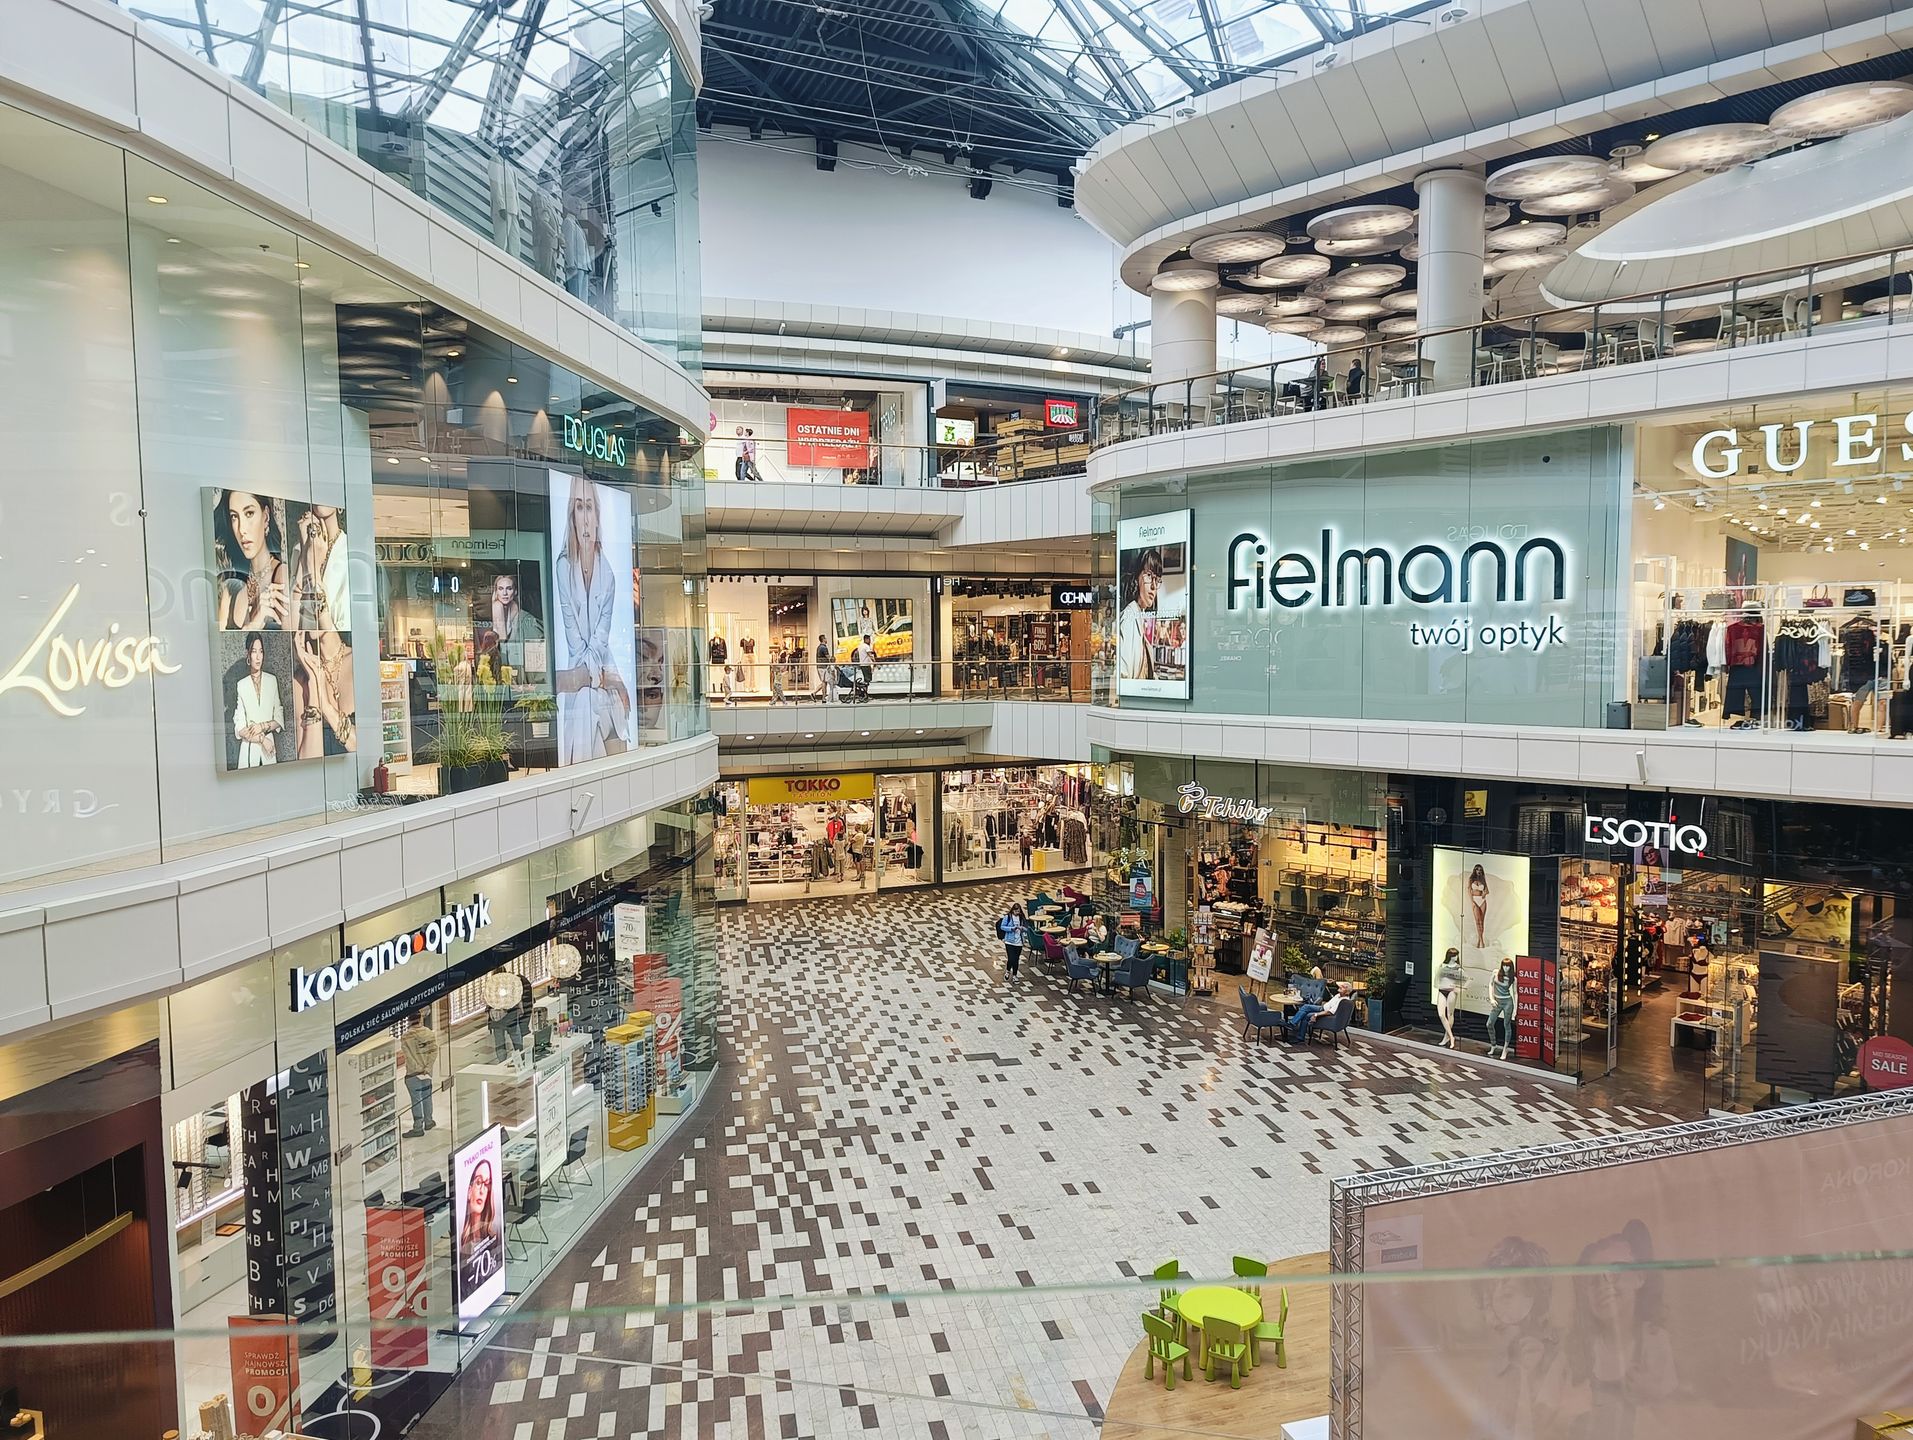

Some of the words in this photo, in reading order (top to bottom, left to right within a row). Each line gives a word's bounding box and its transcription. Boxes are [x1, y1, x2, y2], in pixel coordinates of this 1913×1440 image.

[797, 424, 842, 435] OSTATNIE
[844, 427, 860, 436] DNI
[563, 414, 626, 467] DOUGLAS
[1139, 525, 1166, 538] fielmann
[1226, 528, 1565, 610] fielmann
[1410, 617, 1474, 652] twój
[1479, 616, 1565, 651] optyk
[0, 582, 183, 717] Lovisa
[784, 778, 841, 792] TAKKO
[1203, 796, 1274, 825] Tchibo
[1585, 815, 1708, 855] ESOTIQ
[1518, 970, 1539, 979] SALE
[1544, 974, 1555, 985] SALE
[1518, 986, 1539, 995] SALE
[1544, 990, 1555, 1001] SALE
[340, 1023, 366, 1043] POLSKA
[366, 1015, 381, 1030] SIEĆ
[381, 995, 410, 1025] SALONÓW
[409, 981, 446, 1006] OPTYCZNYCH
[1518, 1002, 1539, 1011] SALE
[1544, 1006, 1555, 1018] SALE
[1518, 1019, 1539, 1028] SALE
[1544, 1023, 1555, 1034] SALE
[1518, 1035, 1539, 1044] SALE
[1544, 1040, 1555, 1050] SALE
[1884, 1053, 1908, 1061] SEASON
[1871, 1059, 1908, 1075] SALE
[285, 1147, 311, 1170] W
[380, 1250, 420, 1259] PROMOCJE
[468, 1249, 497, 1285] -70%
[244, 1351, 280, 1360] SPRAWDŹ
